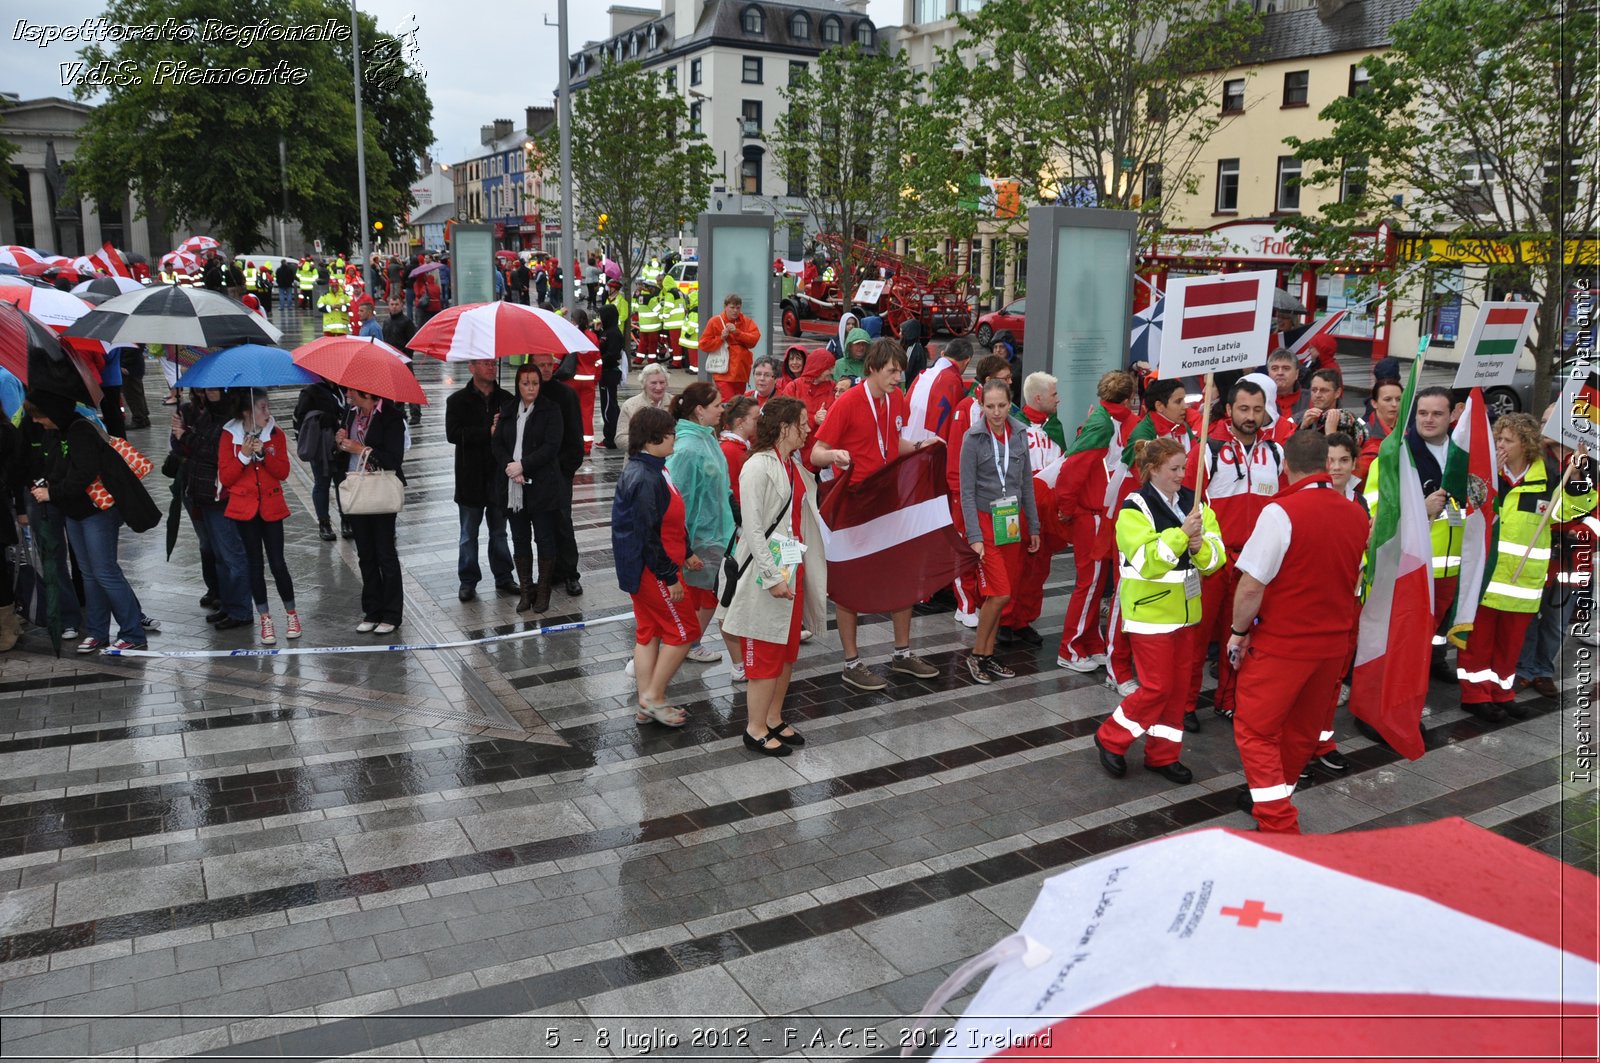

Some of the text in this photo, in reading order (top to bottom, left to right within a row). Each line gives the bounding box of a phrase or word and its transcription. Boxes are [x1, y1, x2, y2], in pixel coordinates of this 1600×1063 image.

[1192, 341, 1241, 355] Team Latvia
[1181, 352, 1248, 369] Komanda Latvija
